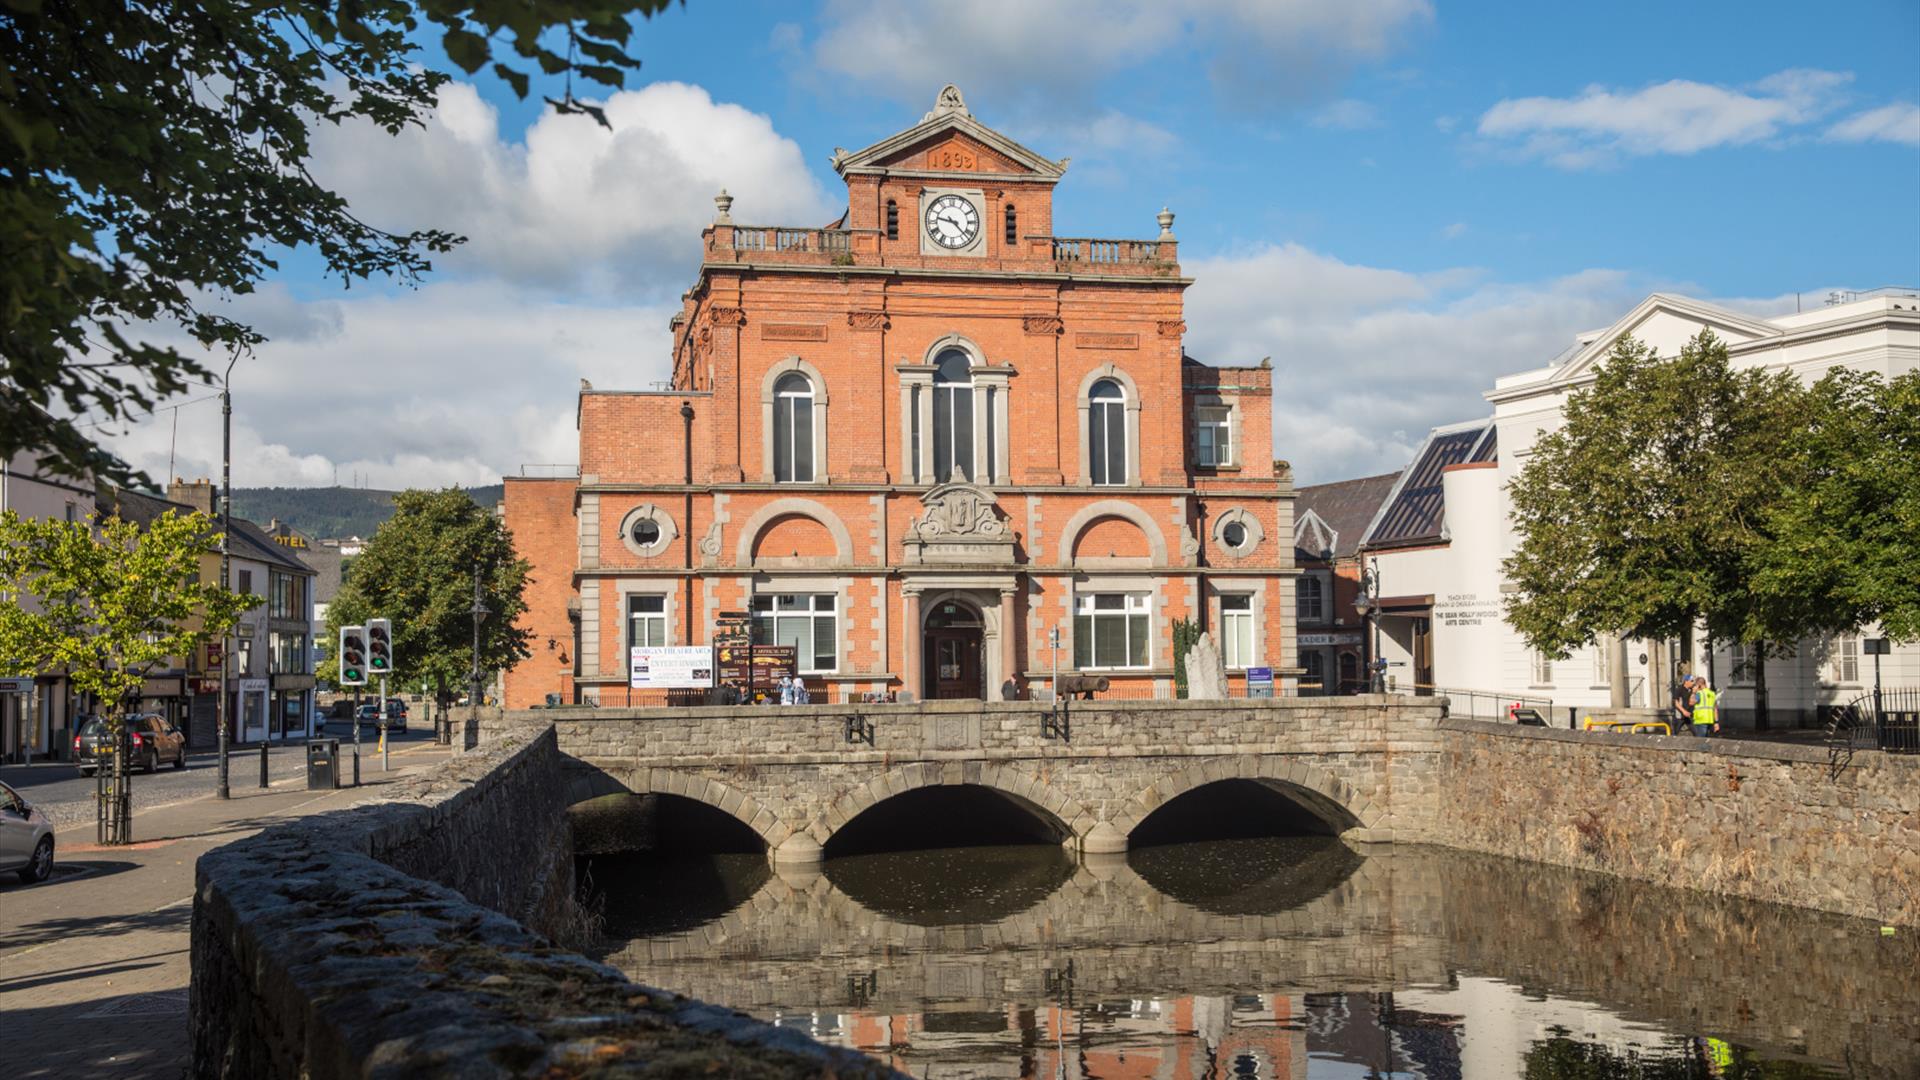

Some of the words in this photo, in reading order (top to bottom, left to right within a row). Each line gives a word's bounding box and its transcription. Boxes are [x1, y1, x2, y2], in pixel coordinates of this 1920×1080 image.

[933, 152, 973, 168] 1893
[273, 535, 306, 548] OTEL
[1458, 610, 1498, 618] HOLLYWOOD
[1458, 618, 1482, 626] CENTRE
